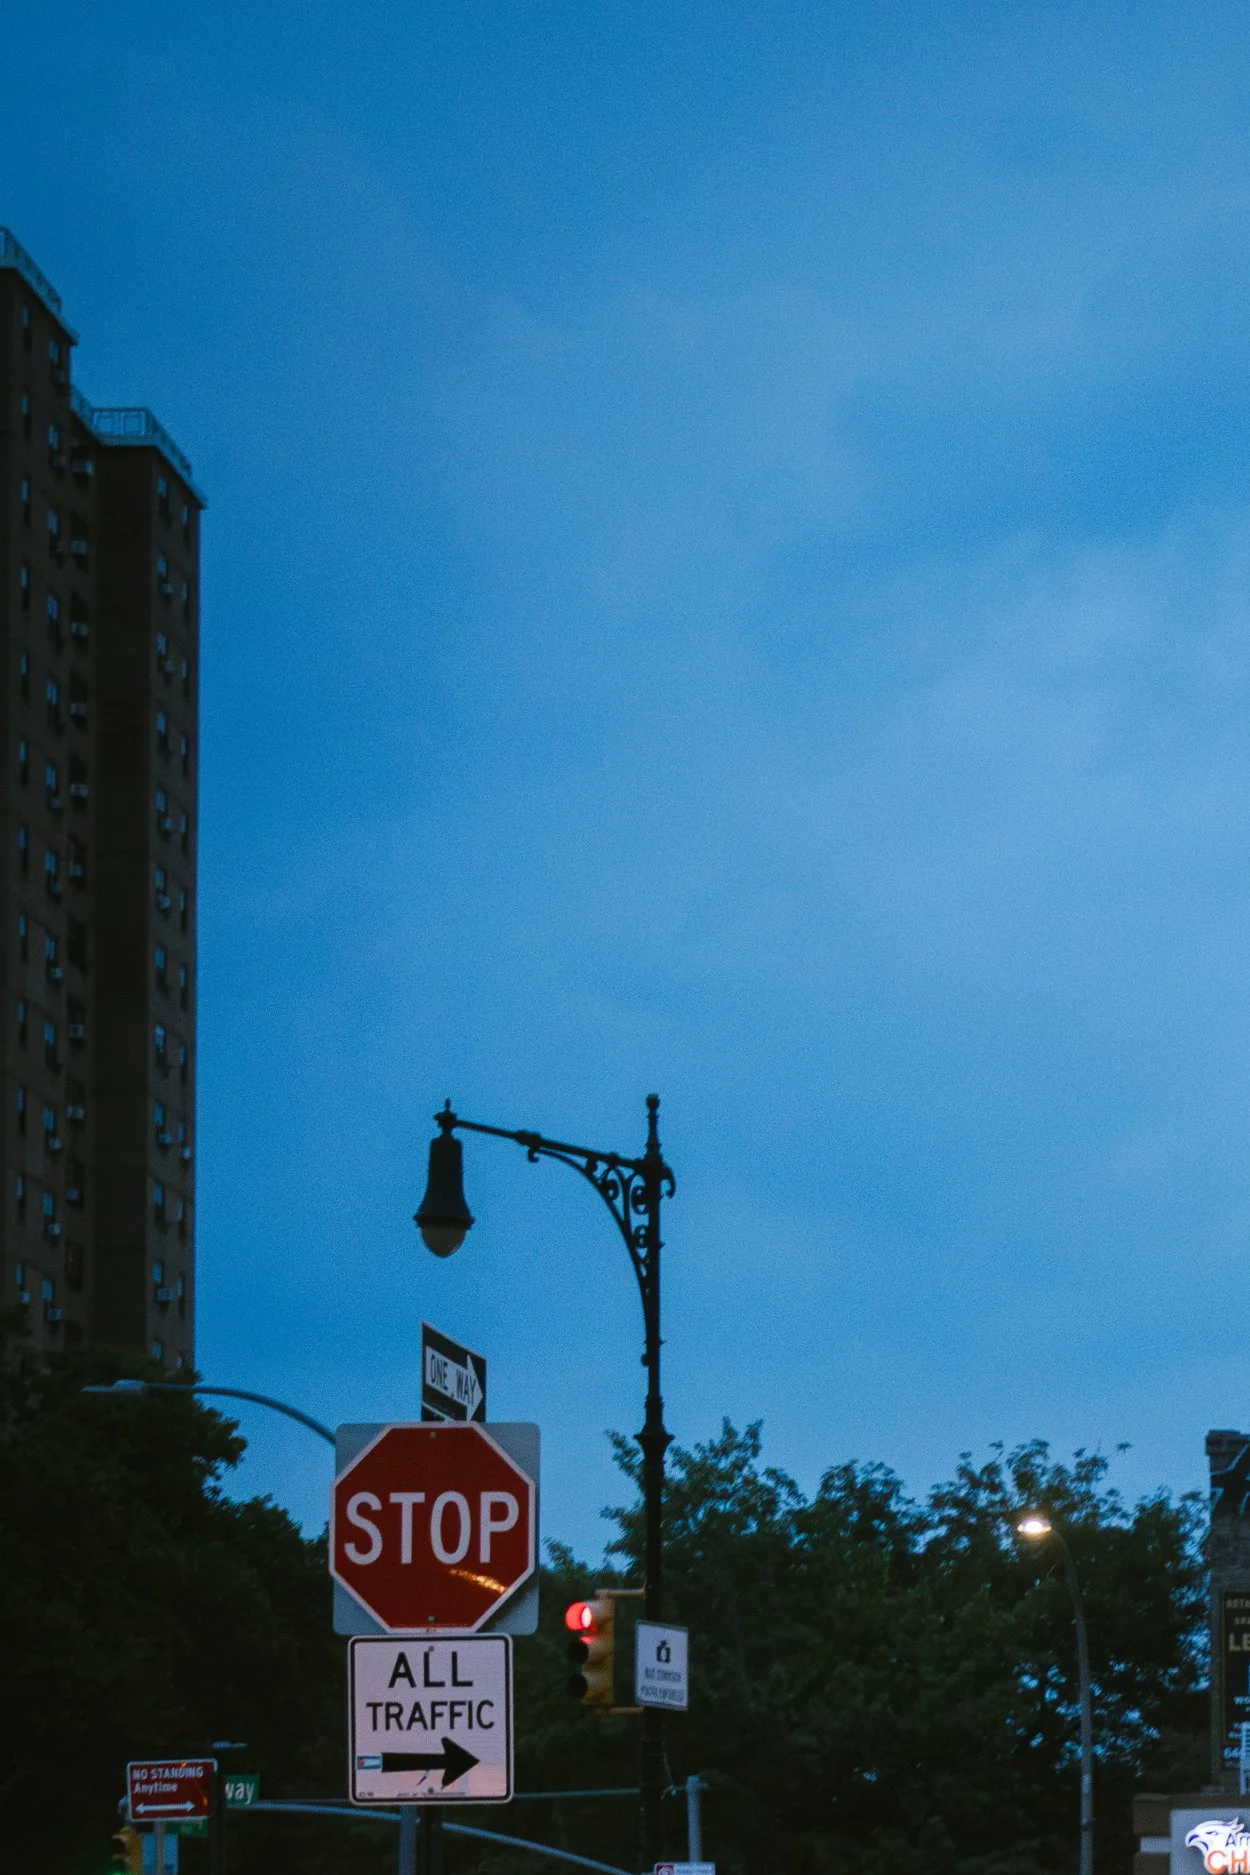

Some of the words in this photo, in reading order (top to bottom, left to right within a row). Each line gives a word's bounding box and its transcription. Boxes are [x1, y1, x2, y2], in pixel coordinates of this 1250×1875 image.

[430, 1354, 448, 1392] ONE
[456, 1369, 477, 1405] WAY
[344, 1492, 519, 1565] STOP
[388, 1651, 473, 1689] ALL
[366, 1701, 495, 1732] TRAFFIC
[133, 1768, 148, 1780] NO
[150, 1766, 203, 1780] STANDING
[134, 1782, 178, 1795] Anytime
